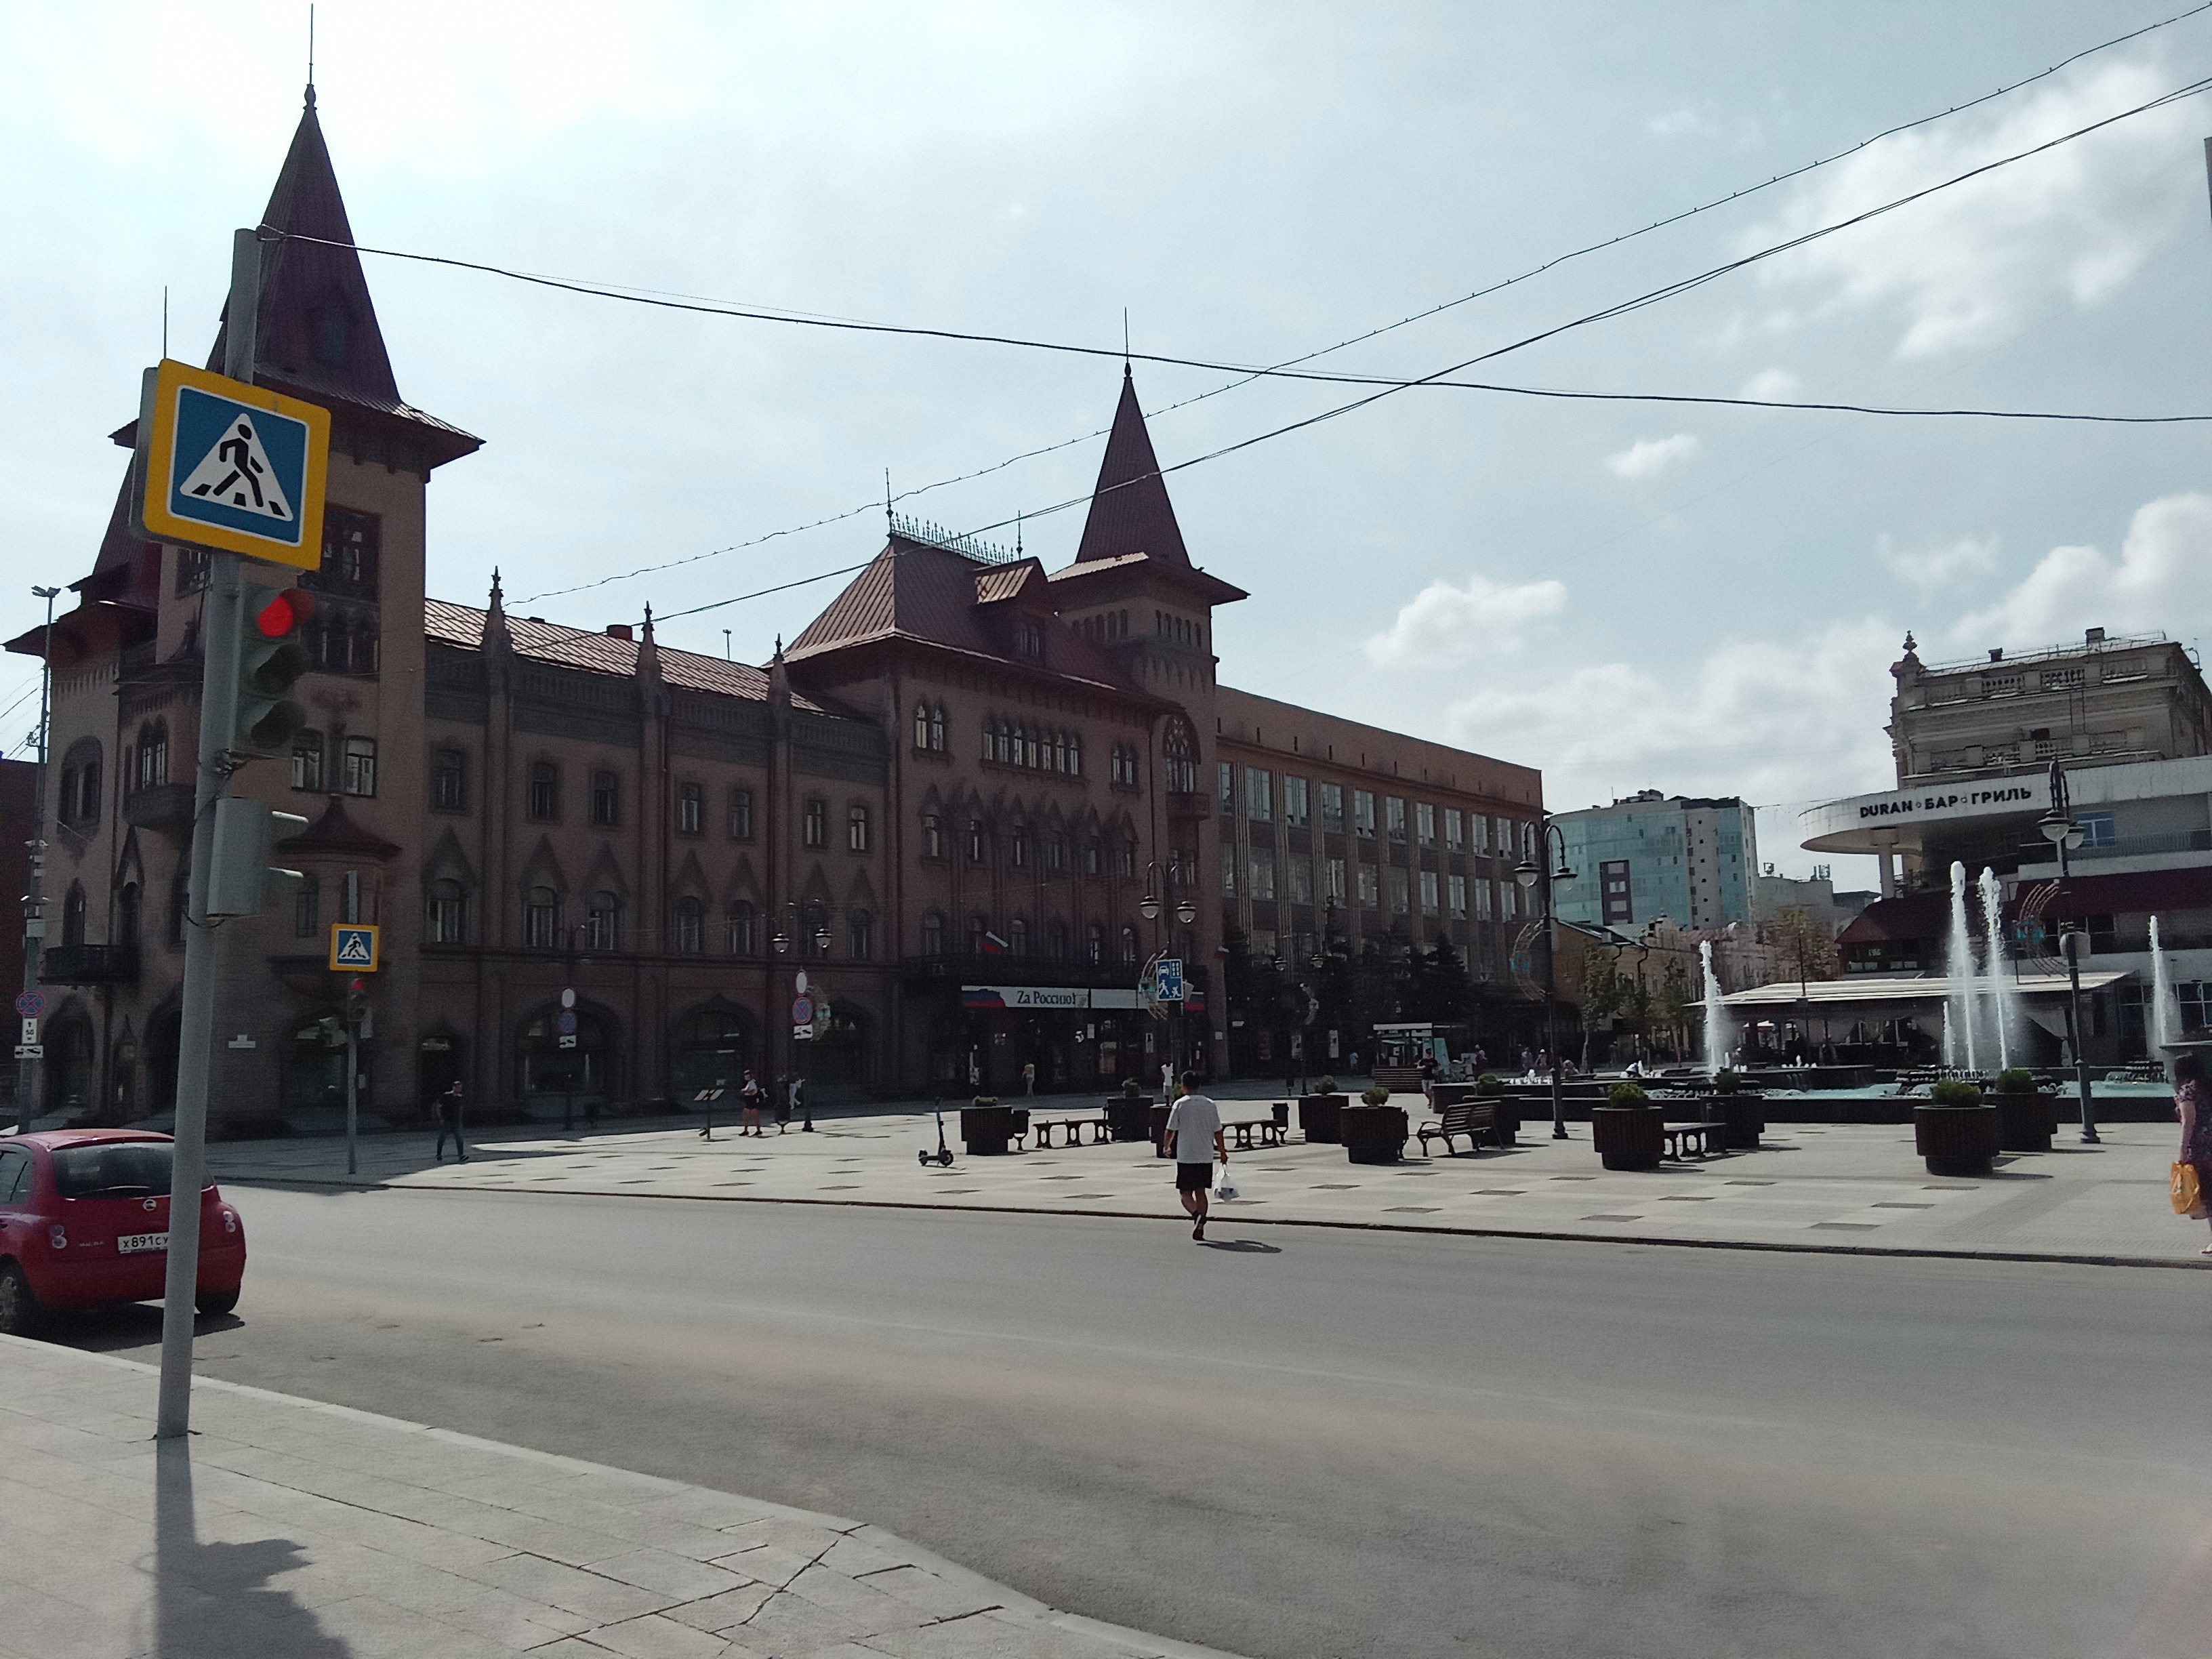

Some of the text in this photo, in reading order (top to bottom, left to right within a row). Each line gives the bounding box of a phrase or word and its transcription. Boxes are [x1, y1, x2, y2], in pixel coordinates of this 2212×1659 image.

[1860, 787, 2032, 818] DURAN БАР ГРИЛЬ
[1017, 990, 1076, 1005] Za Россию!
